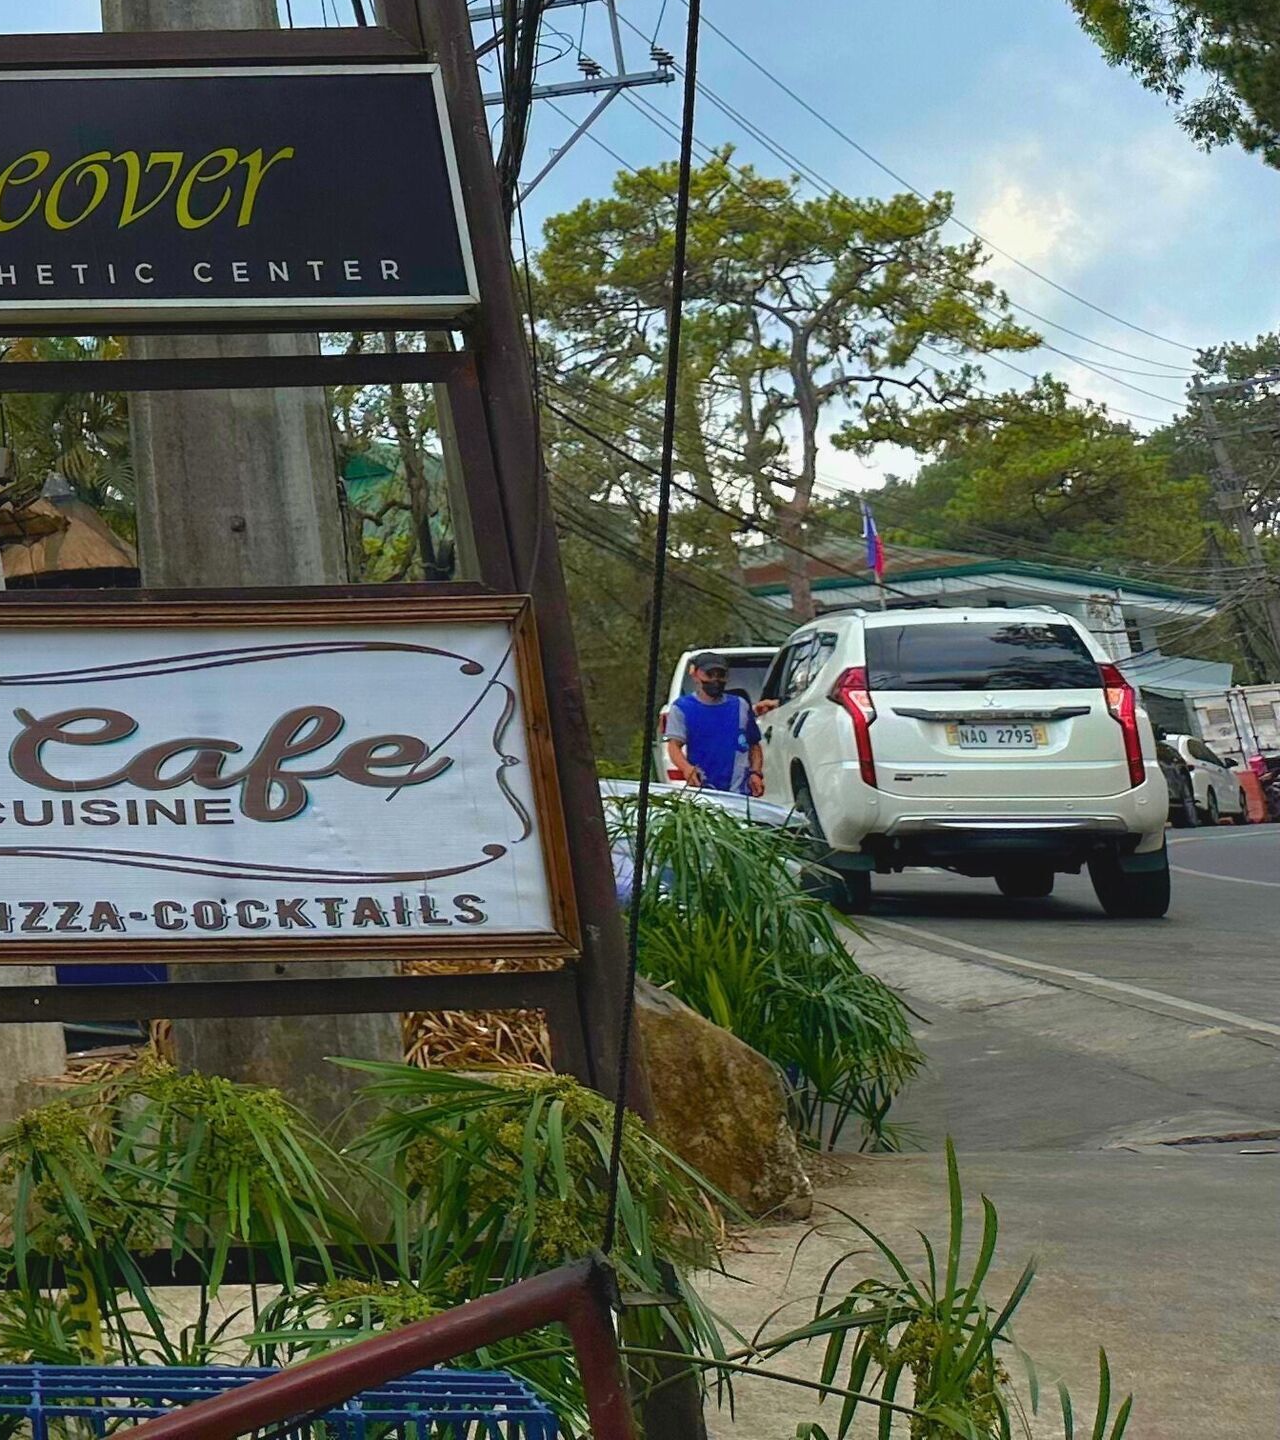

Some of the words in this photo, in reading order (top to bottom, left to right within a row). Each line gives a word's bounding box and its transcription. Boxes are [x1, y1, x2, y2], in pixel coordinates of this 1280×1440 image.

[192, 257, 406, 284] CENTER
[997, 728, 1033, 744] 2795
[7, 703, 454, 823] Cafe
